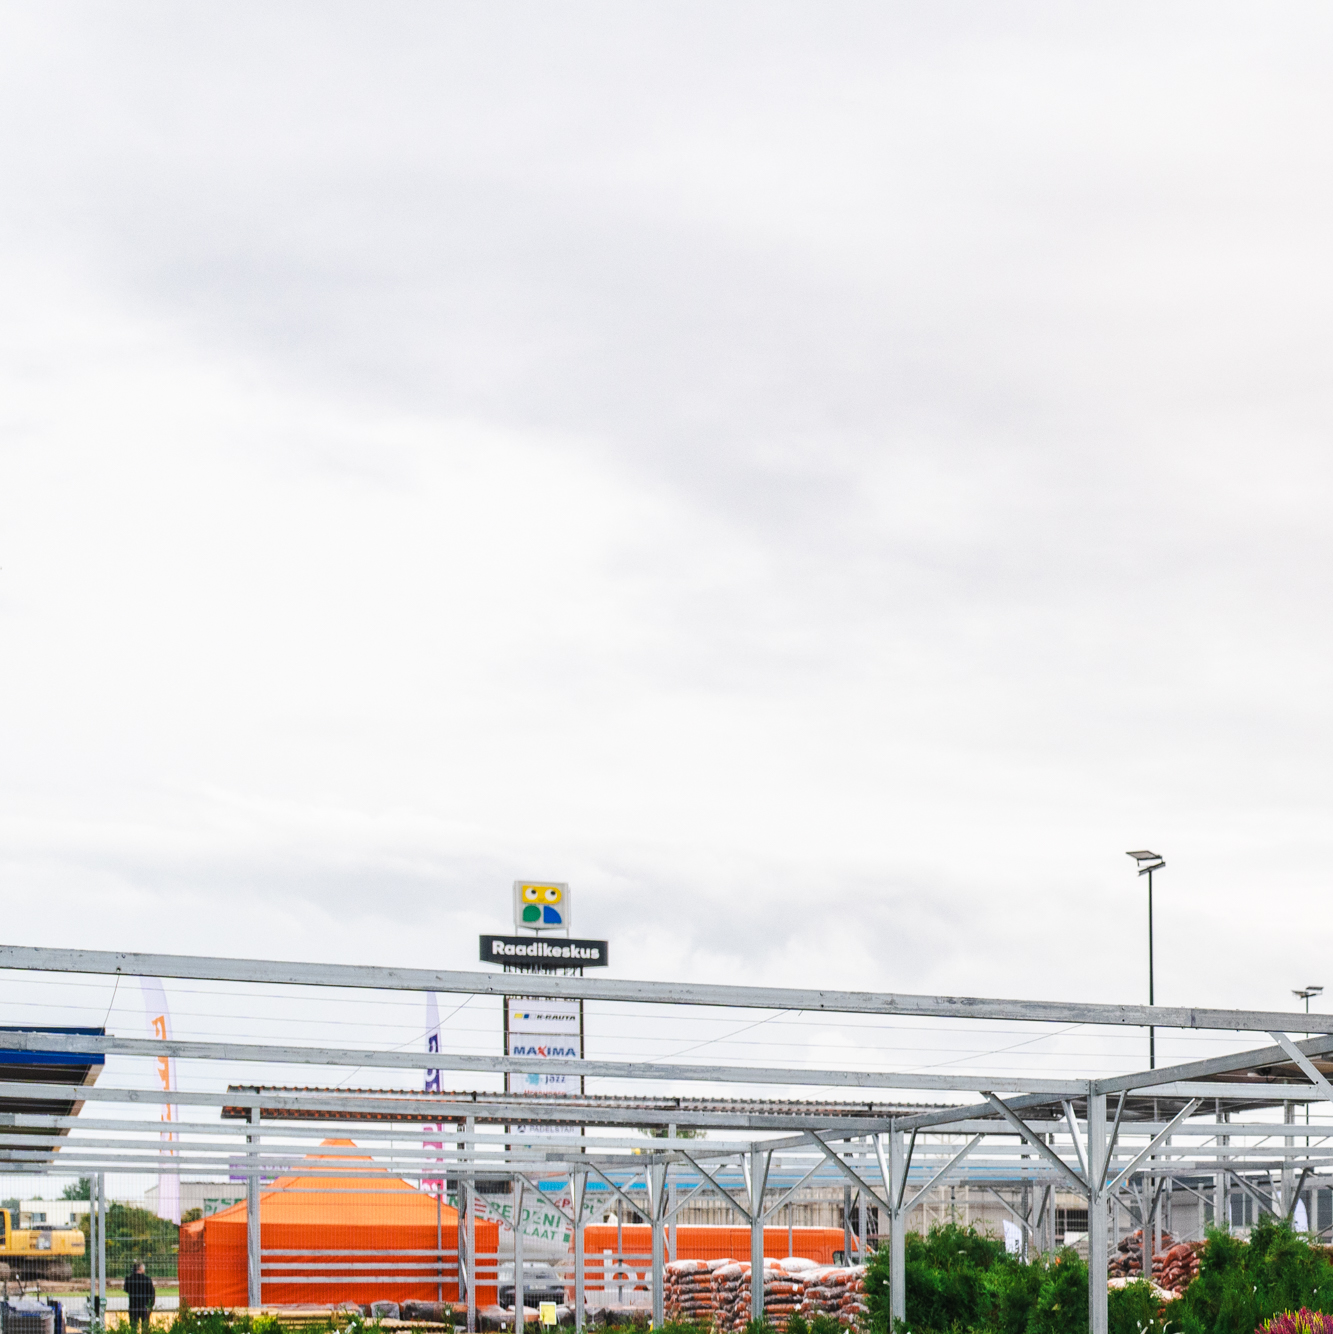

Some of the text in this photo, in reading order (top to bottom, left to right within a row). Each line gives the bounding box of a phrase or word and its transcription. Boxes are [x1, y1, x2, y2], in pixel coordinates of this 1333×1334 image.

[491, 940, 600, 960] Raadikeskus
[513, 1044, 576, 1058] MAXIMA
[488, 1201, 562, 1228] REDNI
[523, 1227, 558, 1241] LAAT
